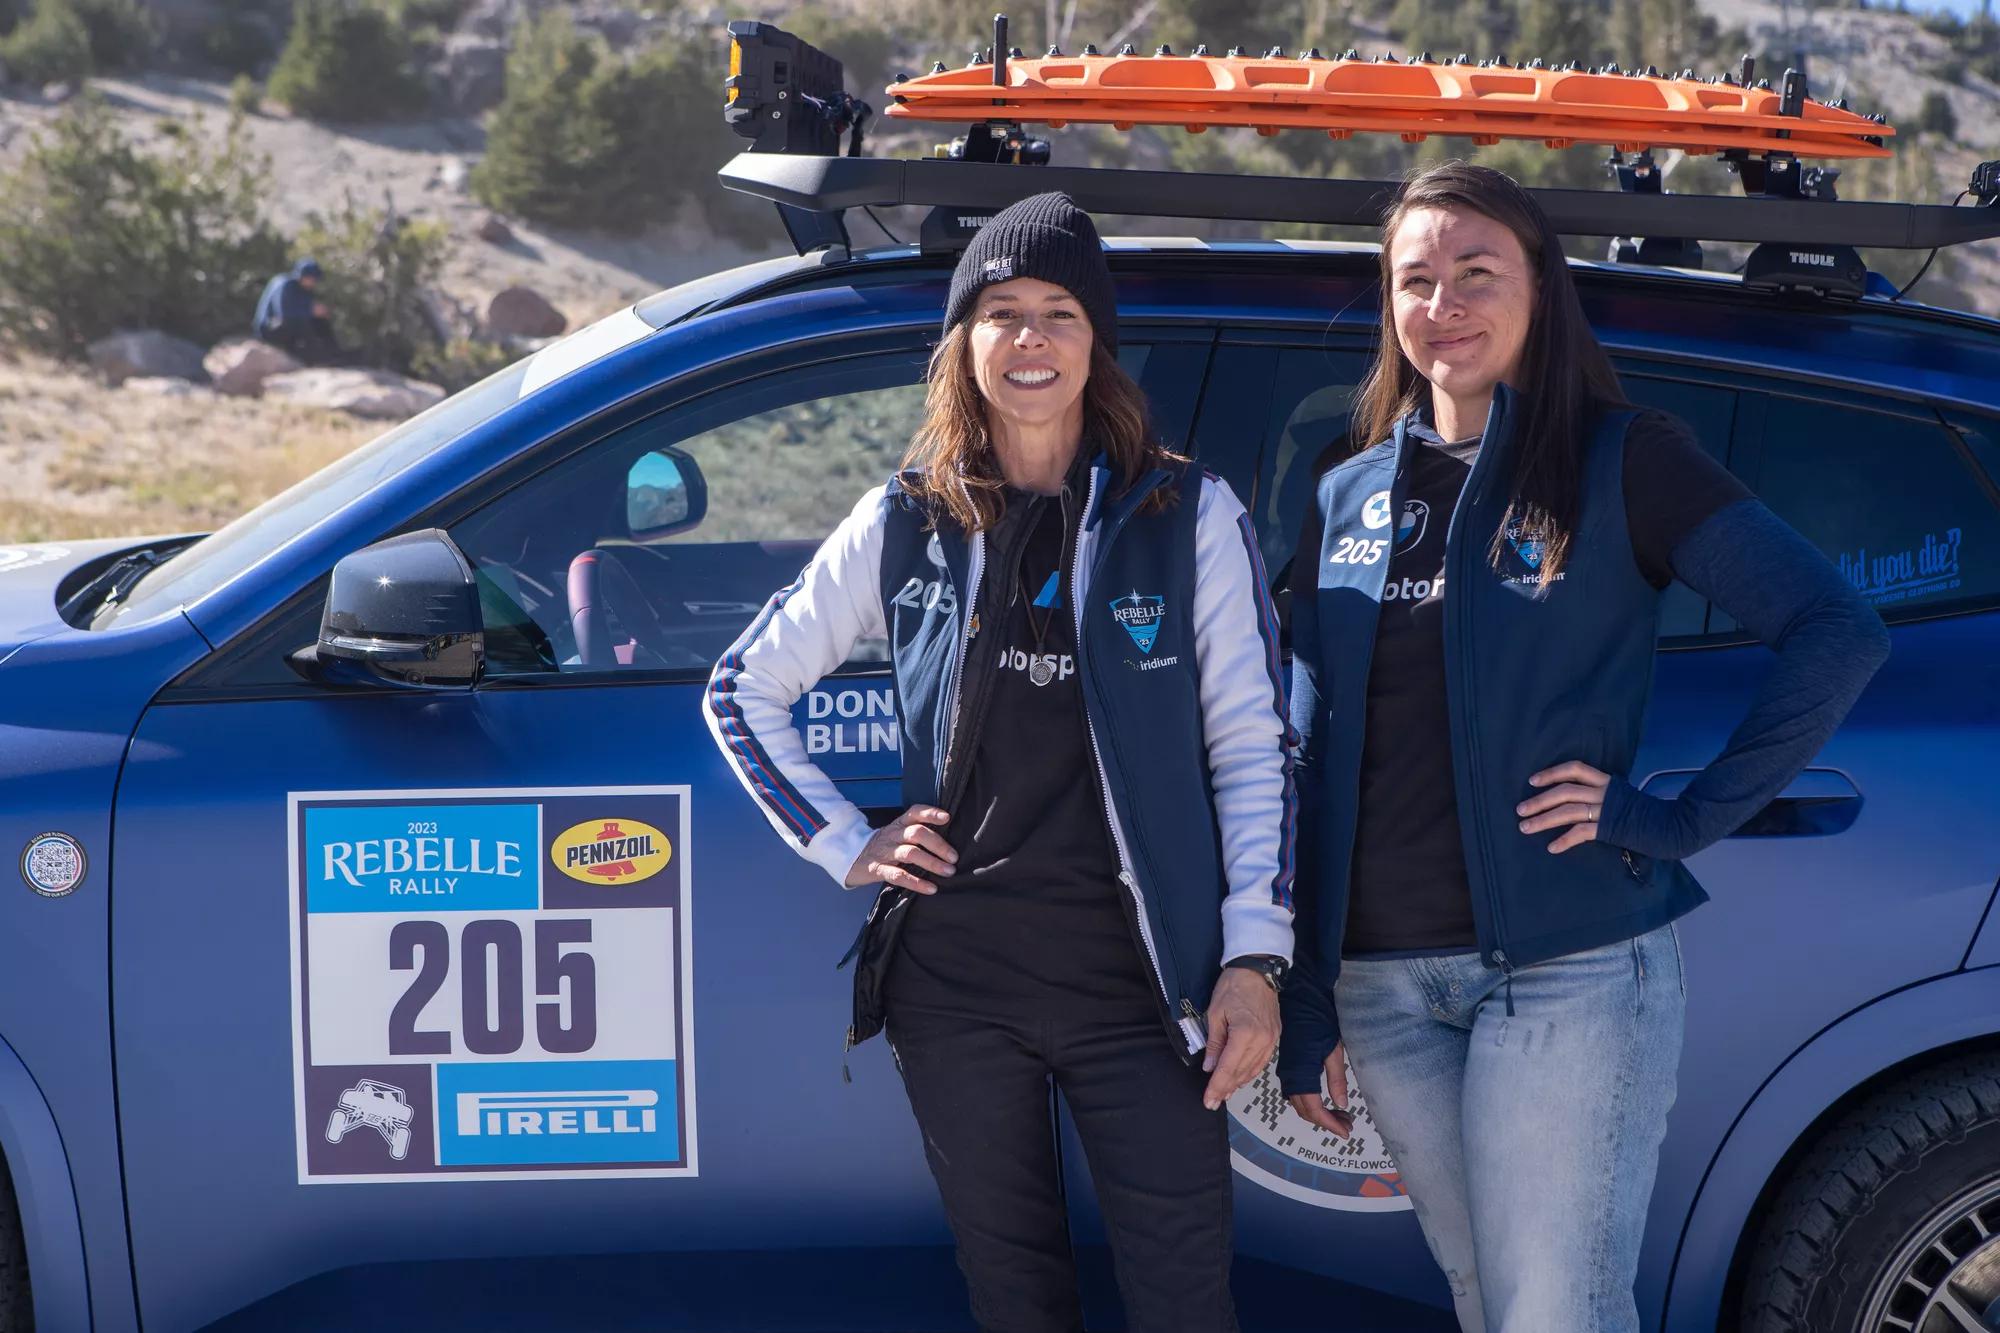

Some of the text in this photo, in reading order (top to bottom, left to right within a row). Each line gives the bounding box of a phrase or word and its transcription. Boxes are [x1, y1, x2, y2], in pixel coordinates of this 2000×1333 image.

[957, 216, 993, 228] THU
[1789, 252, 1835, 267] THULE
[1330, 537, 1389, 565] 205
[1872, 551, 1914, 590] you
[1919, 527, 1961, 576] die?
[898, 577, 956, 614] 205
[1114, 605, 1166, 623] REBELLE
[1132, 617, 1150, 625] RALLY
[1139, 656, 1176, 671] iridium
[808, 689, 893, 720] DON
[806, 722, 899, 754] BLIN
[407, 822, 438, 835] 2023
[322, 837, 522, 887] REBELLE
[566, 836, 656, 868] PENNZOIL
[389, 878, 458, 895] RALLY
[388, 918, 598, 1056] 205
[456, 1089, 659, 1137] PIRELLI
